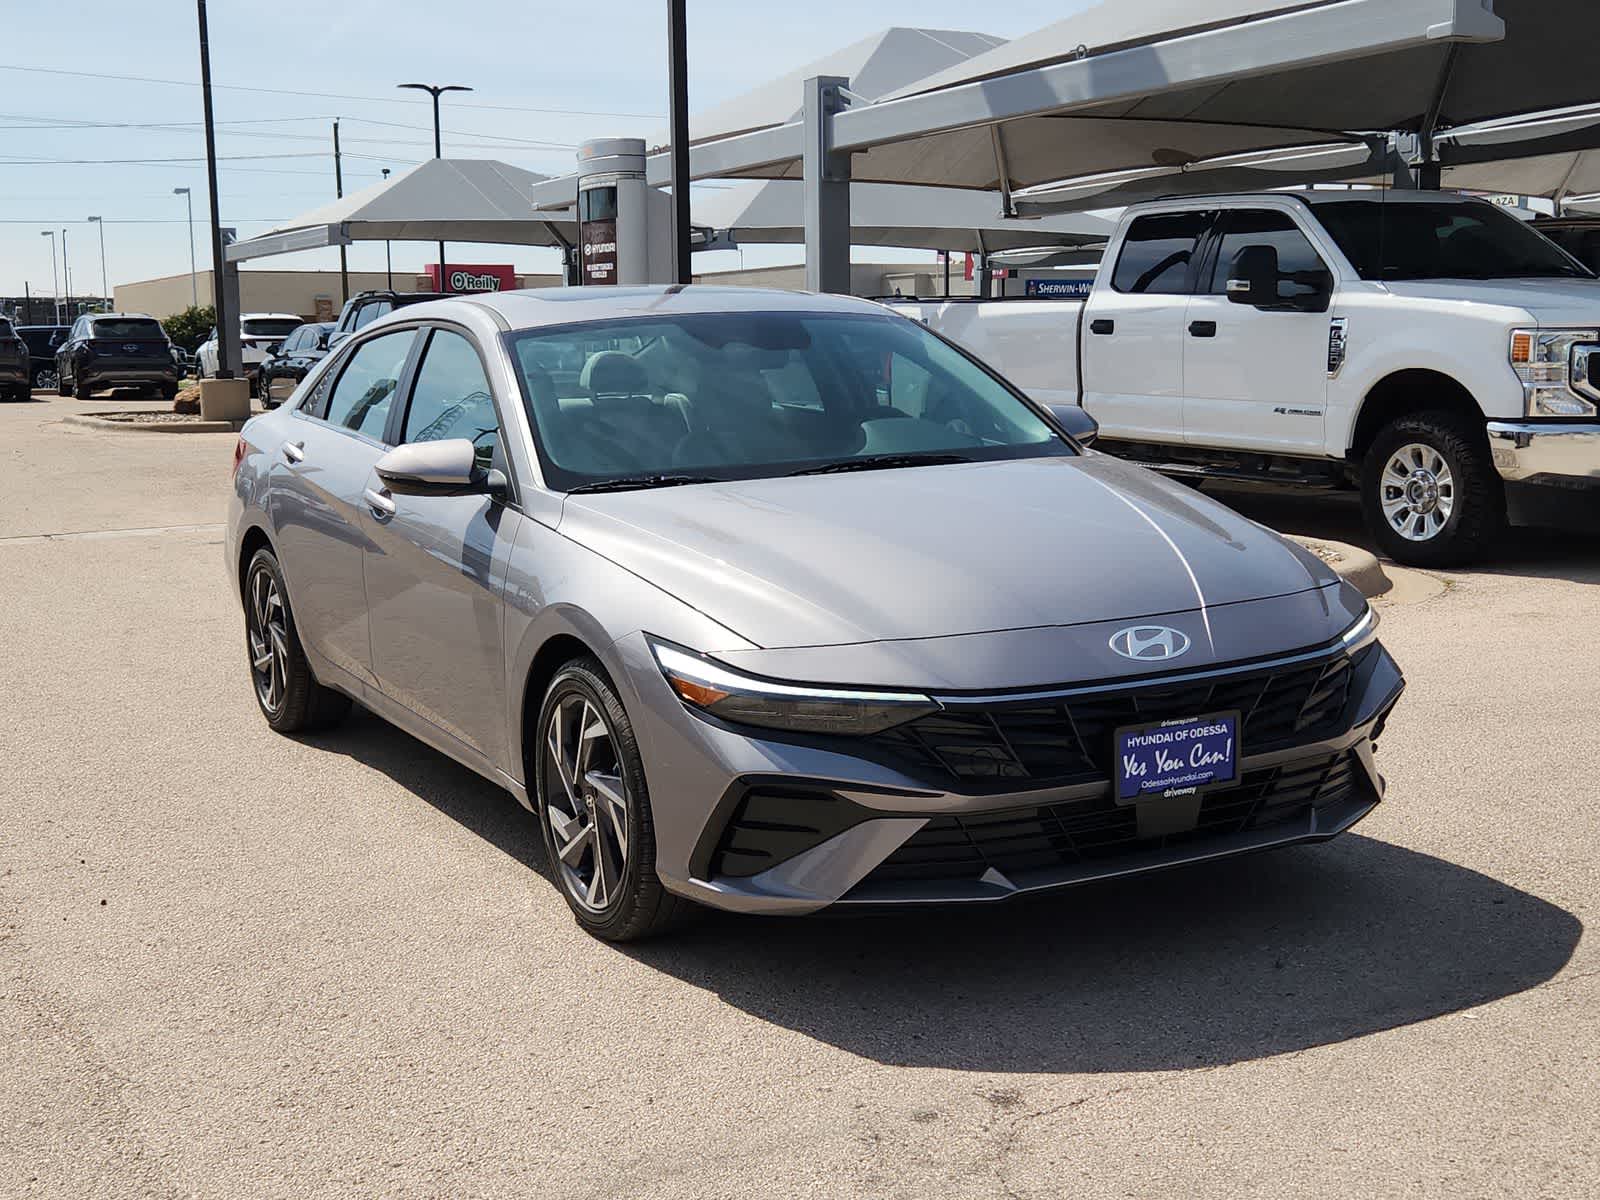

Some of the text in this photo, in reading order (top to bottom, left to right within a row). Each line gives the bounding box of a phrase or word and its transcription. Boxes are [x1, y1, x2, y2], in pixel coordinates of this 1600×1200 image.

[451, 271, 500, 292] O'Reilly
[1127, 724, 1228, 748] HYUNDAI OF ODESSA
[1122, 737, 1232, 779] Yes You Can!
[1141, 770, 1214, 789] OdessaHyundai.com
[1163, 786, 1197, 798] driveway
